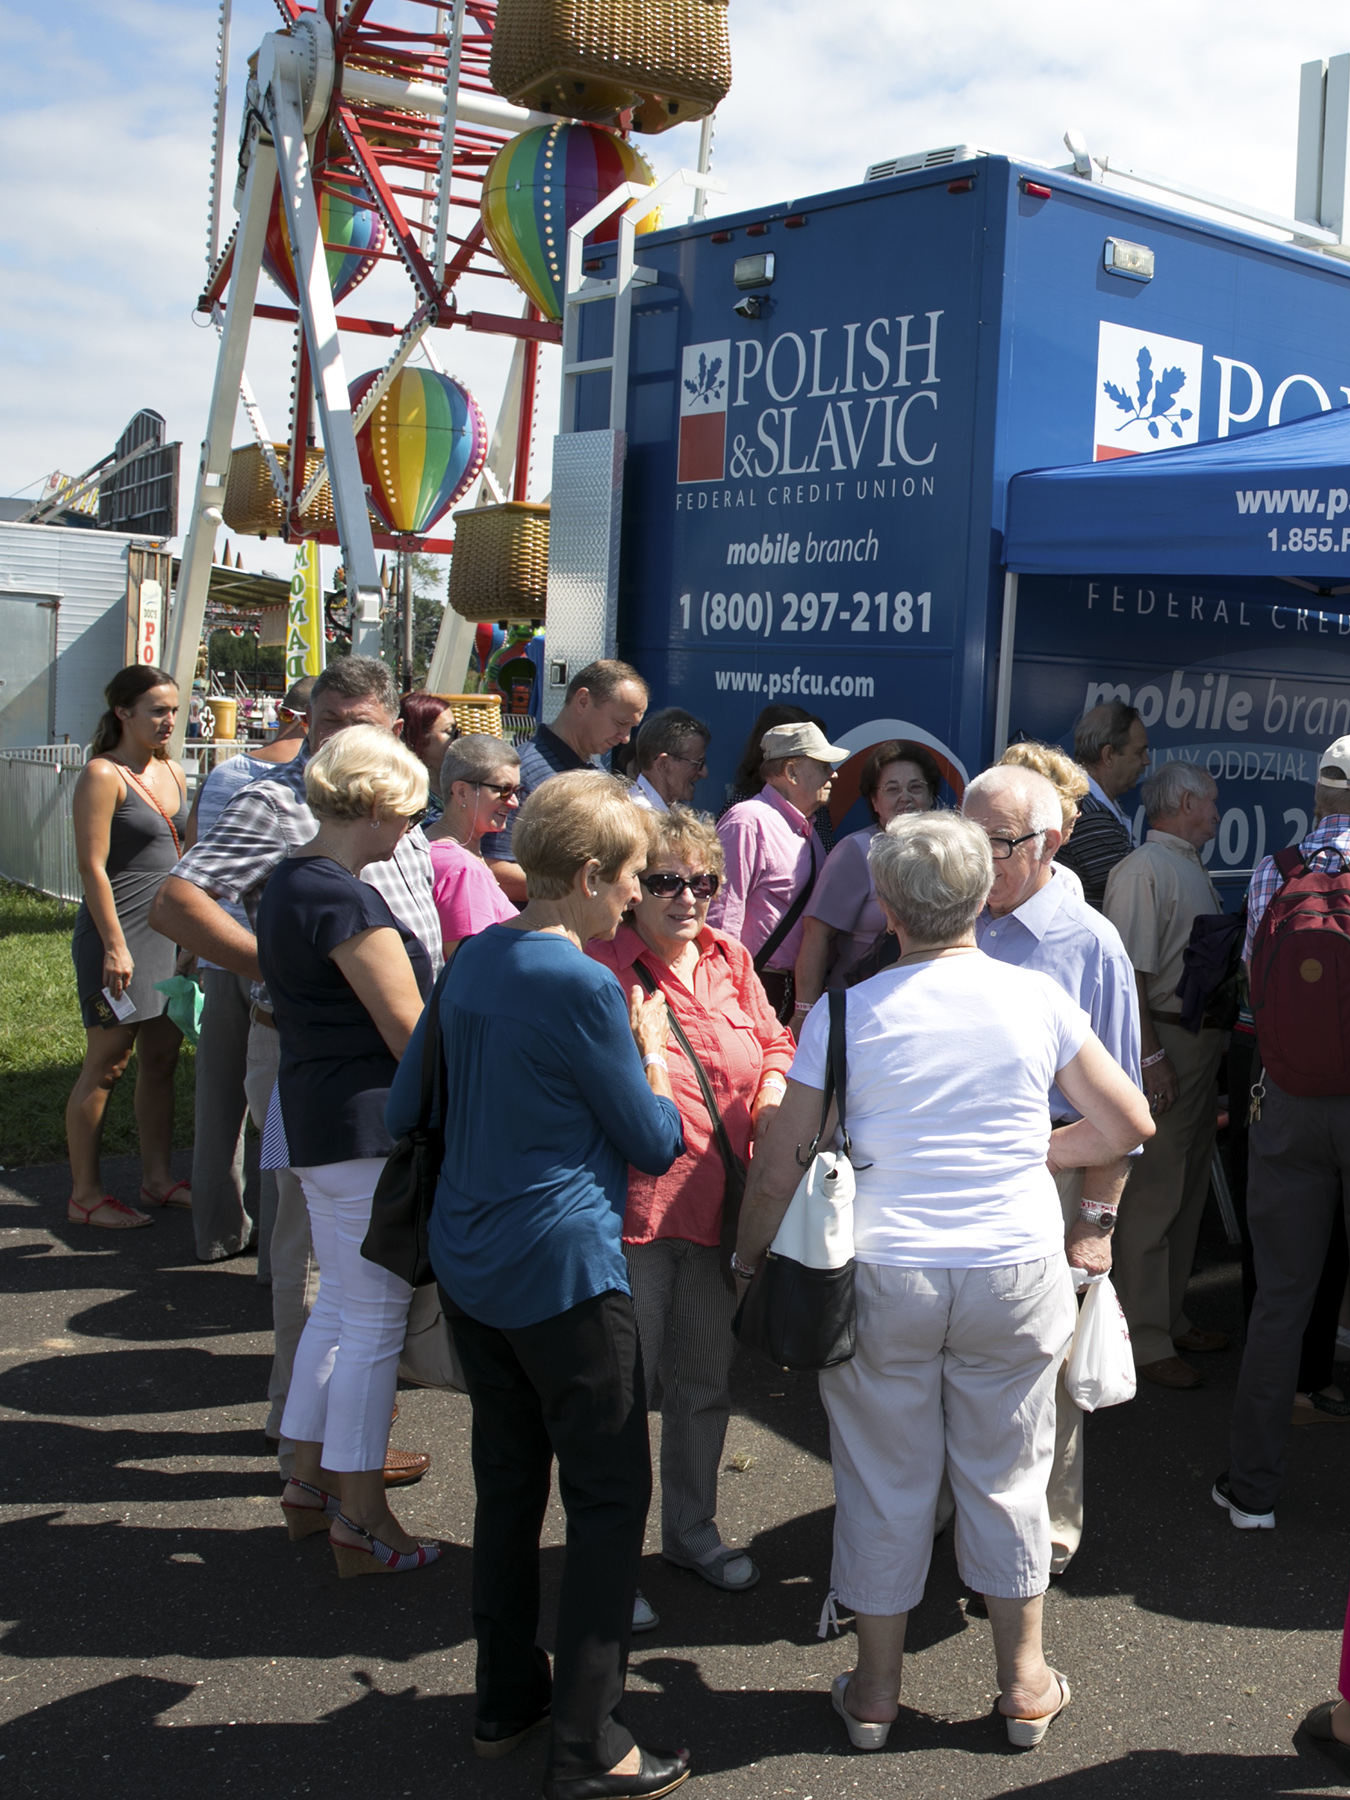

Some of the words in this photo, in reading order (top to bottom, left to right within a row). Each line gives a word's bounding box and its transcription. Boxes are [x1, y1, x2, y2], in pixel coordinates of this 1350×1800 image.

[732, 309, 945, 407] POLISH
[675, 488, 758, 512] FEDERAL
[767, 482, 846, 506] CREDIT
[856, 476, 935, 500] UNION
[726, 532, 801, 565] mobile
[804, 528, 880, 564] branch
[679, 592, 692, 630] 1
[700, 590, 774, 638] (800)
[779, 591, 933, 634] 297-2181
[1087, 582, 1252, 627] FEDERAL
[714, 665, 876, 701] www.psfcu.com
[1205, 749, 1310, 781] ODDZIAŁ
